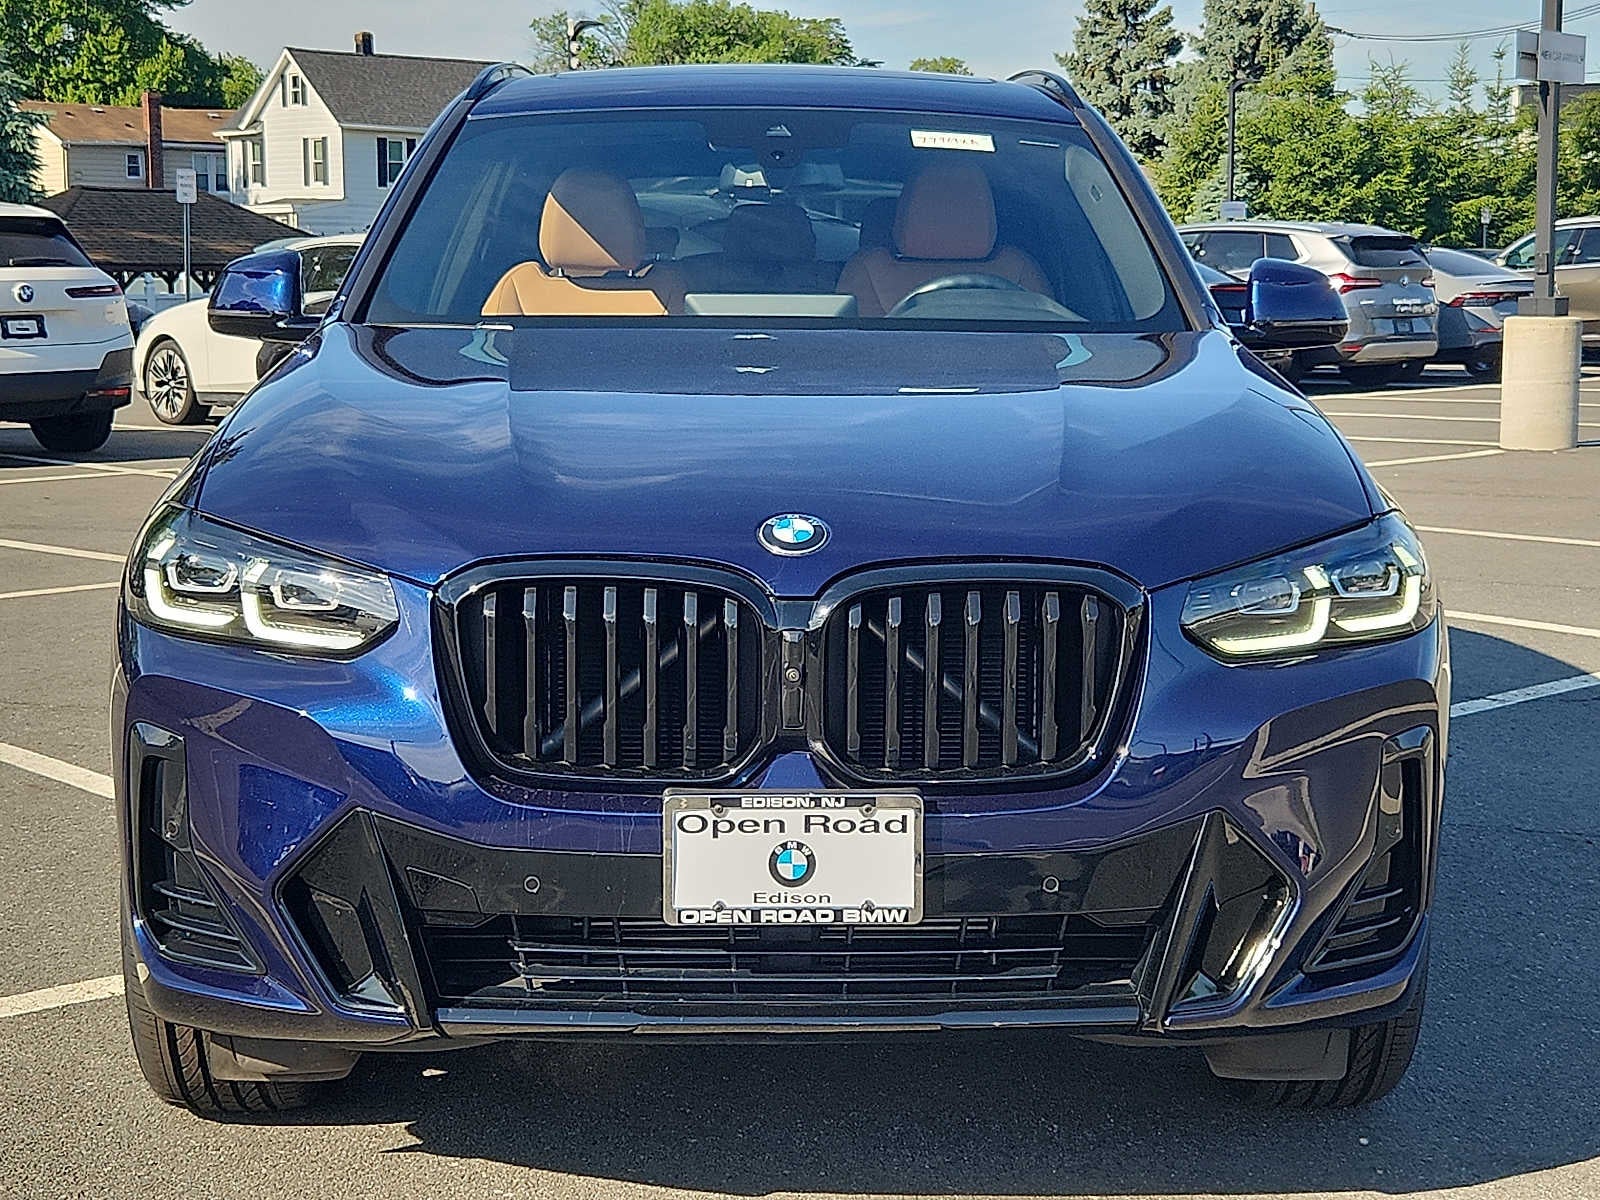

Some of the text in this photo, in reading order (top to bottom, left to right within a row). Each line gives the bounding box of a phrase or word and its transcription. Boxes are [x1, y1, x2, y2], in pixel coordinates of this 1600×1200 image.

[741, 797, 846, 809] EDISON, NJ
[677, 814, 908, 839] Open Road
[774, 841, 812, 856] BMW
[753, 892, 831, 904] Edison
[680, 909, 907, 924] OPEN ROAD BMW
